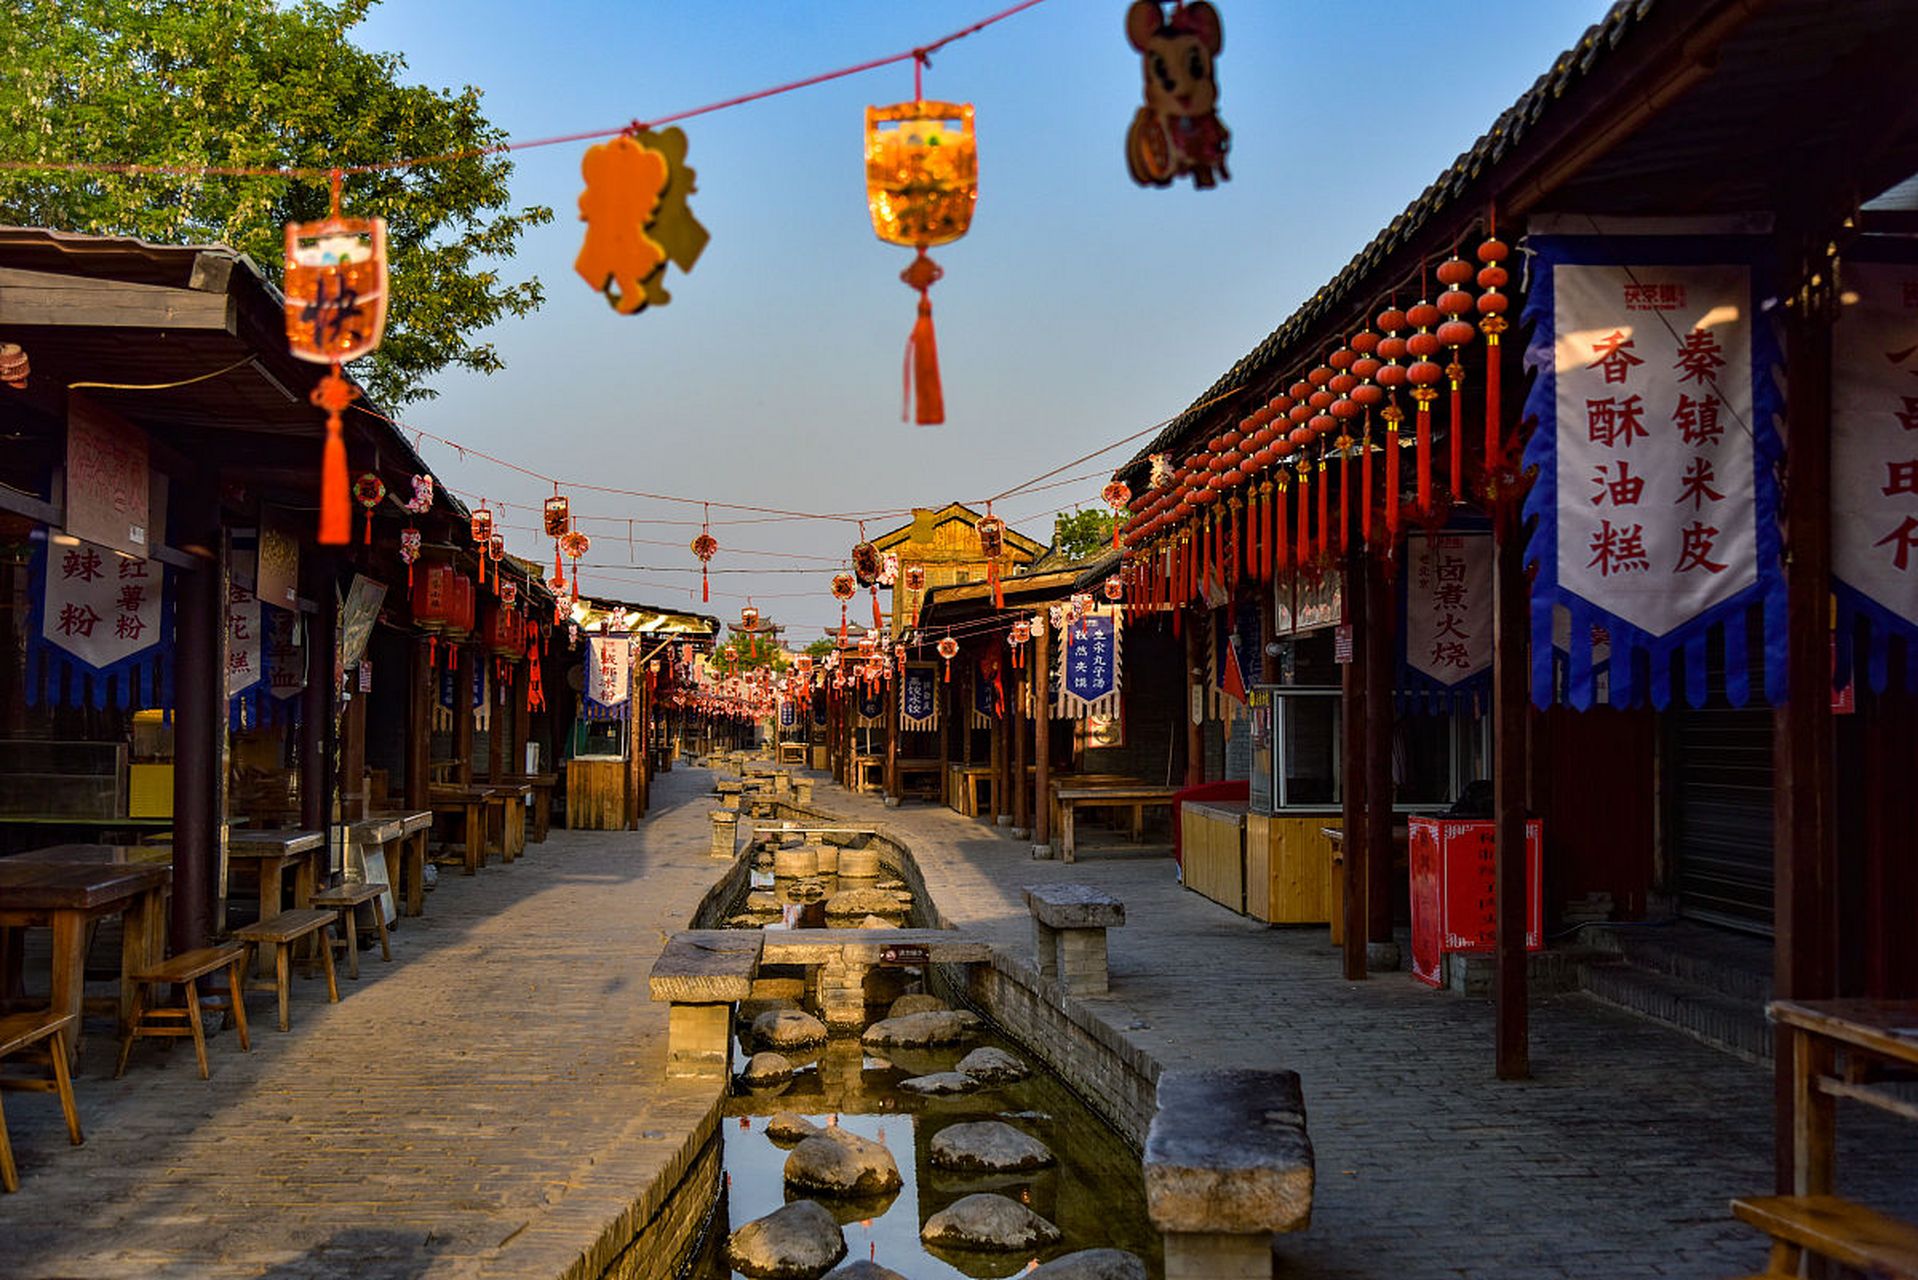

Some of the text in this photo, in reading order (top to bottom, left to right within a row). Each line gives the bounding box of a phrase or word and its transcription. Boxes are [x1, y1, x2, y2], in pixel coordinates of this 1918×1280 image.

[1585, 330, 1650, 577] 香酥油糕
[1673, 329, 1729, 575] 秦镇米皮
[114, 557, 149, 641] 红薯粉
[1430, 555, 1471, 668] 卤煮火烧
